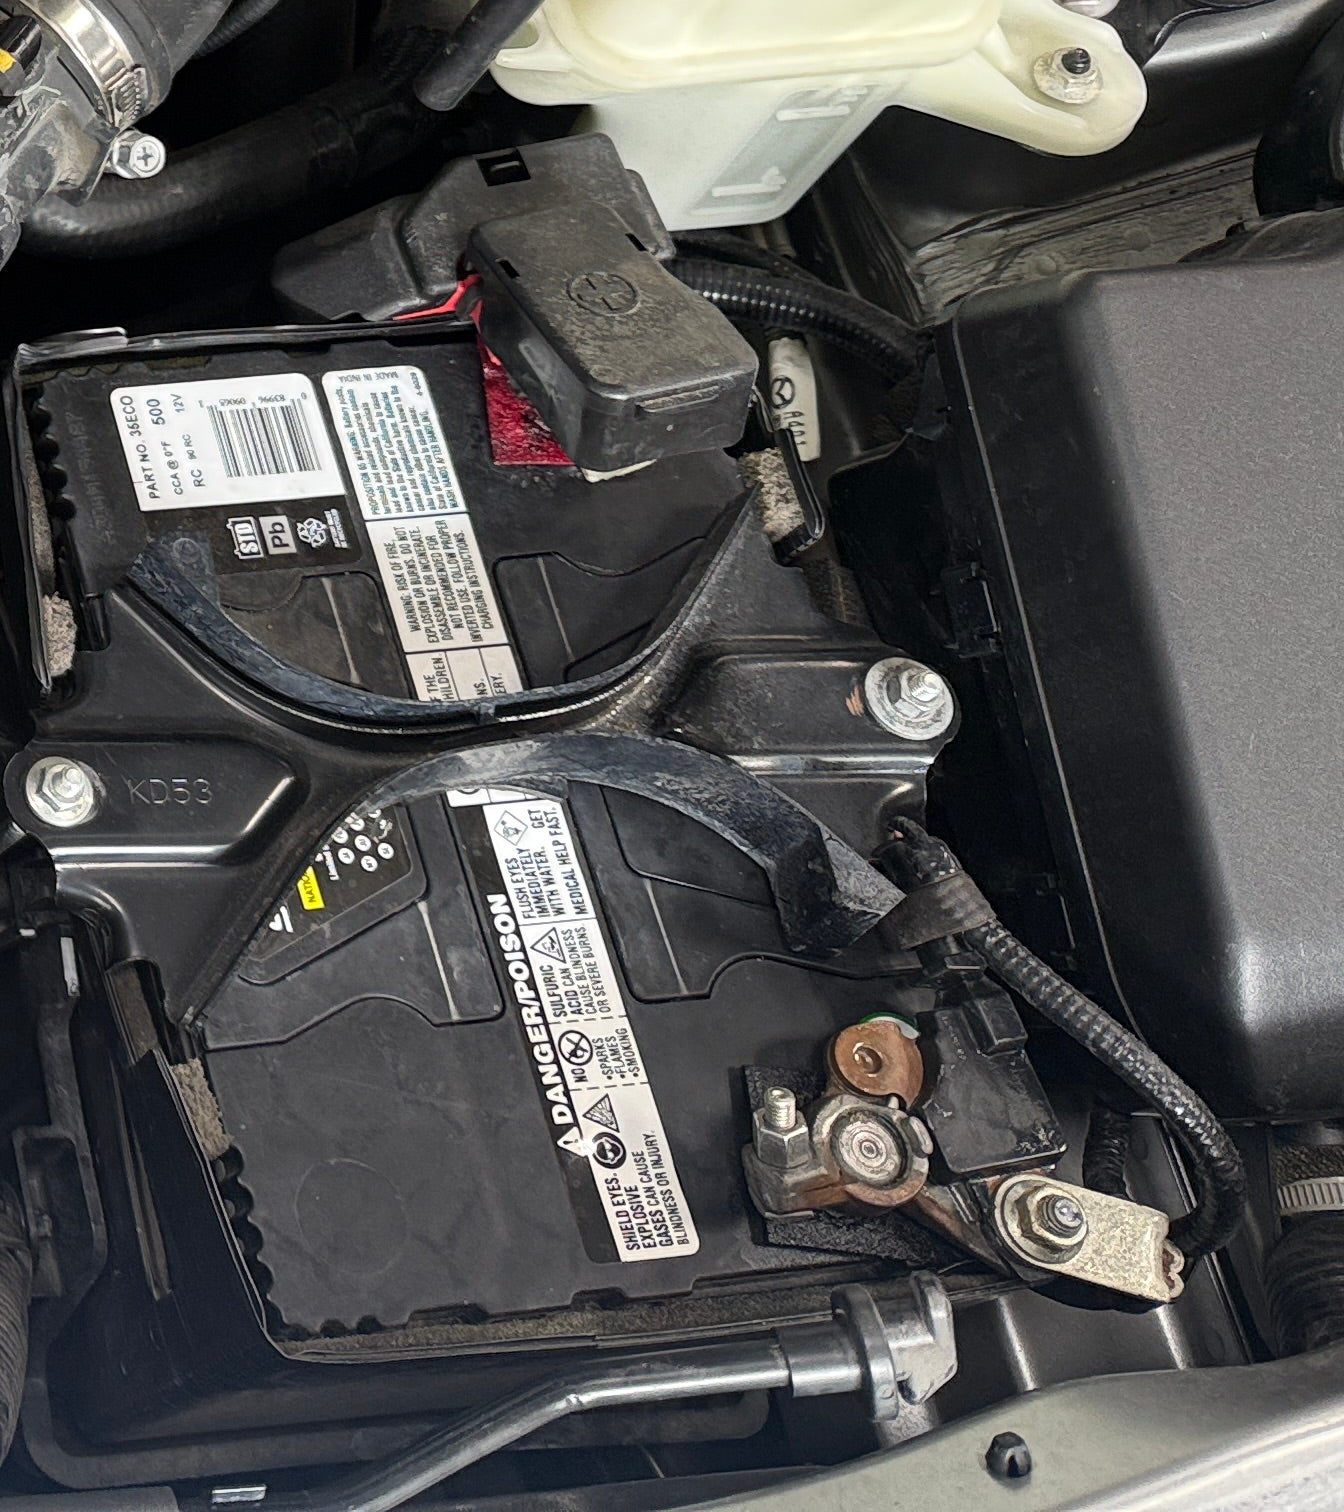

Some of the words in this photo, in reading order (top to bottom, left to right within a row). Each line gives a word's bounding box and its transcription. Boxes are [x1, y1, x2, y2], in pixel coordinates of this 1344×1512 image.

[120, 395, 141, 436] 35ECO
[146, 398, 165, 424] 500
[170, 393, 184, 412] 12V
[136, 444, 149, 461] NO.
[182, 434, 192, 446] RC
[166, 459, 178, 469] @
[190, 469, 205, 486] RC
[141, 466, 159, 498] PART
[170, 473, 183, 495] CCA
[234, 523, 258, 552] STD
[268, 522, 289, 547] Pb
[393, 527, 407, 540] NOT
[425, 535, 439, 550] FOR
[435, 520, 453, 549] PROPER
[398, 543, 412, 554] DO
[409, 530, 431, 572] INCINERATE.
[453, 532, 479, 587] INSTRUCTIONS.
[389, 561, 402, 570] OF
[404, 558, 421, 584] BURNS.
[422, 574, 435, 585] OR
[445, 552, 463, 582] FOLLOW
[393, 573, 408, 590] RISK
[412, 587, 425, 598] OR
[431, 552, 457, 610] RECOMMENDED
[455, 587, 470, 602] USE.
[400, 595, 420, 631] WARNING:
[417, 600, 439, 642] EXPLOSION
[427, 588, 452, 640] DISASSEMBLE
[449, 614, 463, 628] NOT
[461, 605, 482, 641] INVERTED
[471, 589, 493, 629] CHARGING
[423, 674, 438, 693] THE
[432, 657, 453, 699] HILDREN.
[127, 778, 213, 805] KD53
[527, 809, 544, 828] GET
[543, 808, 562, 835] FAST.
[552, 840, 570, 865] HELP
[504, 857, 523, 883] EYES
[533, 850, 554, 886] WATER.
[517, 848, 549, 917] IMMEDIATELY
[562, 868, 587, 914] MEDICAL
[514, 887, 535, 918] FLUSH
[546, 889, 564, 915] WITH
[561, 929, 586, 980] BLINDNESS
[574, 926, 593, 958] BURNS.
[559, 967, 574, 986] CAN
[585, 961, 605, 996] SEVERE
[539, 965, 567, 1017] SULFURIC
[564, 990, 583, 1014] ACID
[577, 984, 596, 1014] CAUSE
[485, 891, 575, 1127] DANGER/POISON
[596, 999, 610, 1012] OR
[571, 1068, 587, 1082] NO
[643, 1134, 663, 1168] INJURY.
[631, 1151, 652, 1182] CAUSE
[654, 1171, 669, 1186] OR
[604, 1173, 625, 1206] EYES.
[643, 1186, 659, 1206] CAN
[615, 1210, 640, 1250] SHIELD
[624, 1186, 656, 1248] EXPLOSIVE
[649, 1209, 673, 1246] GASES
[660, 1189, 688, 1244] BLINDNESS
